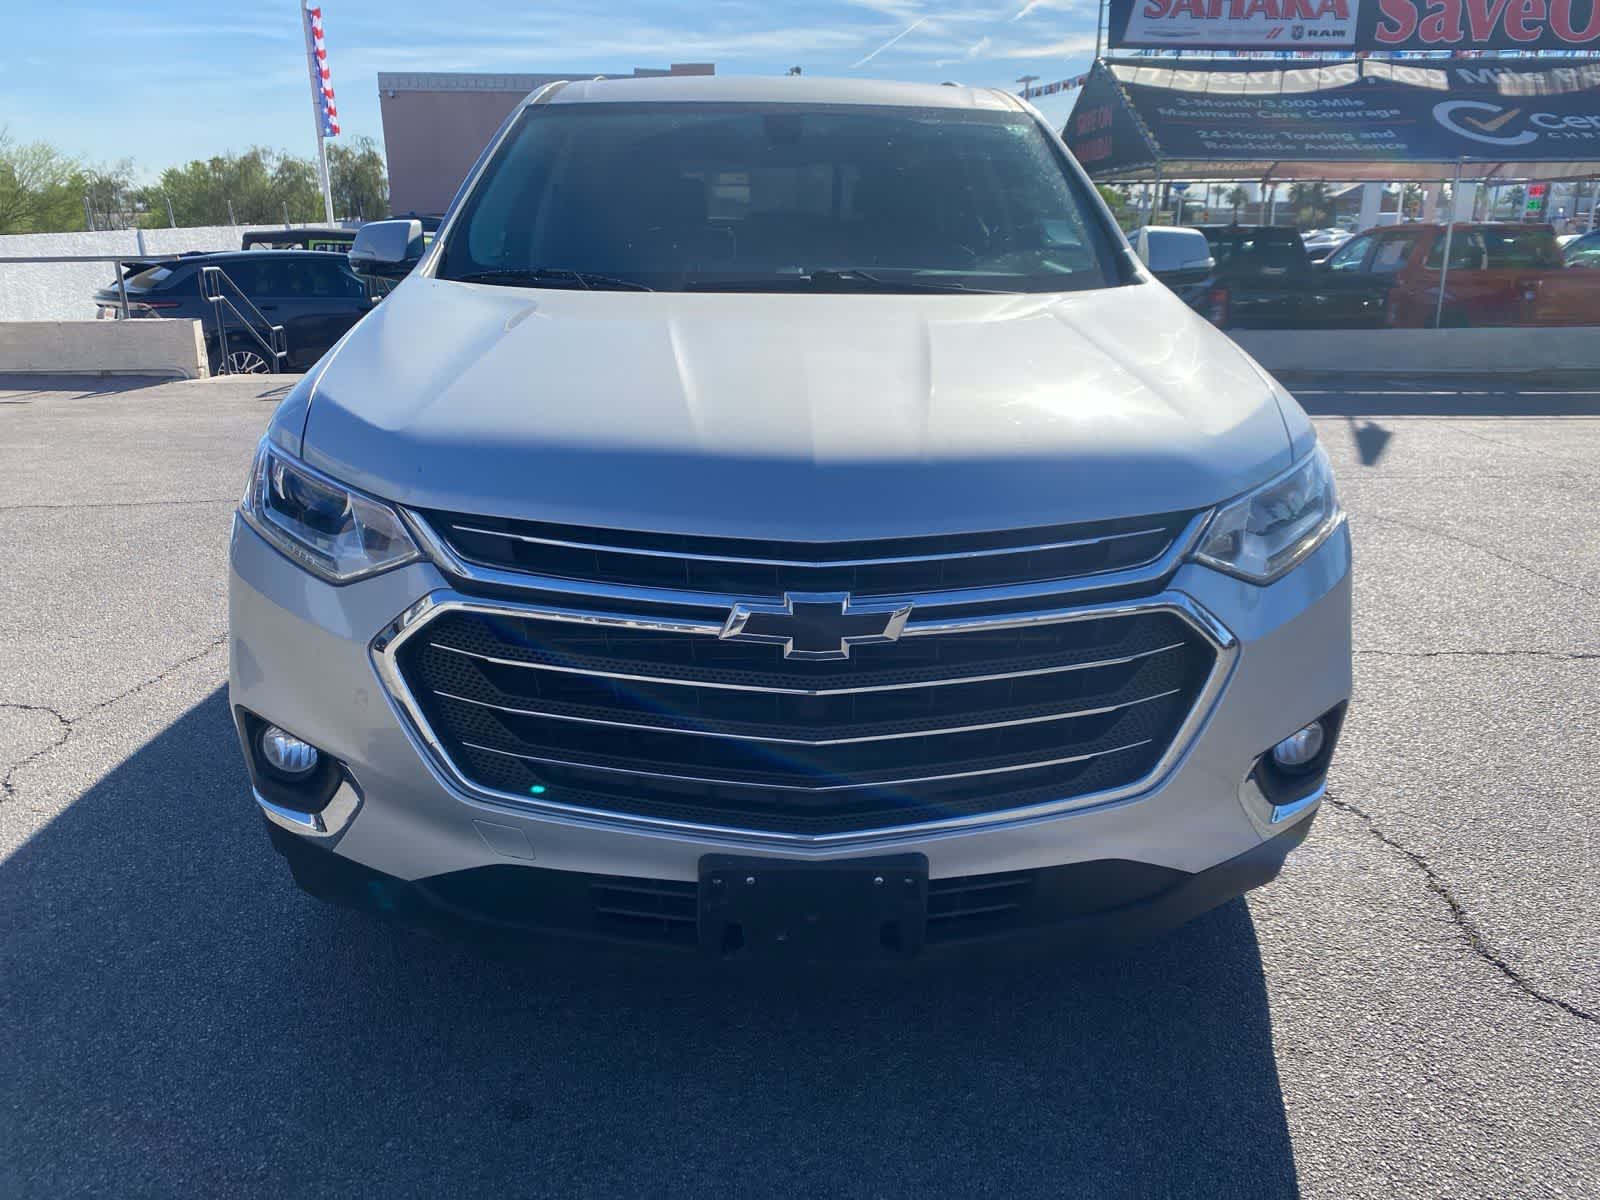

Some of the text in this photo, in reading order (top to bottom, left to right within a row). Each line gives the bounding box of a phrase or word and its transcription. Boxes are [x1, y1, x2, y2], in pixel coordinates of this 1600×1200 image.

[1307, 29, 1347, 38] RAM
[1157, 107, 1401, 119] Maximum Care Coverage
[1196, 129, 1399, 141] 24-Hour Towing and
